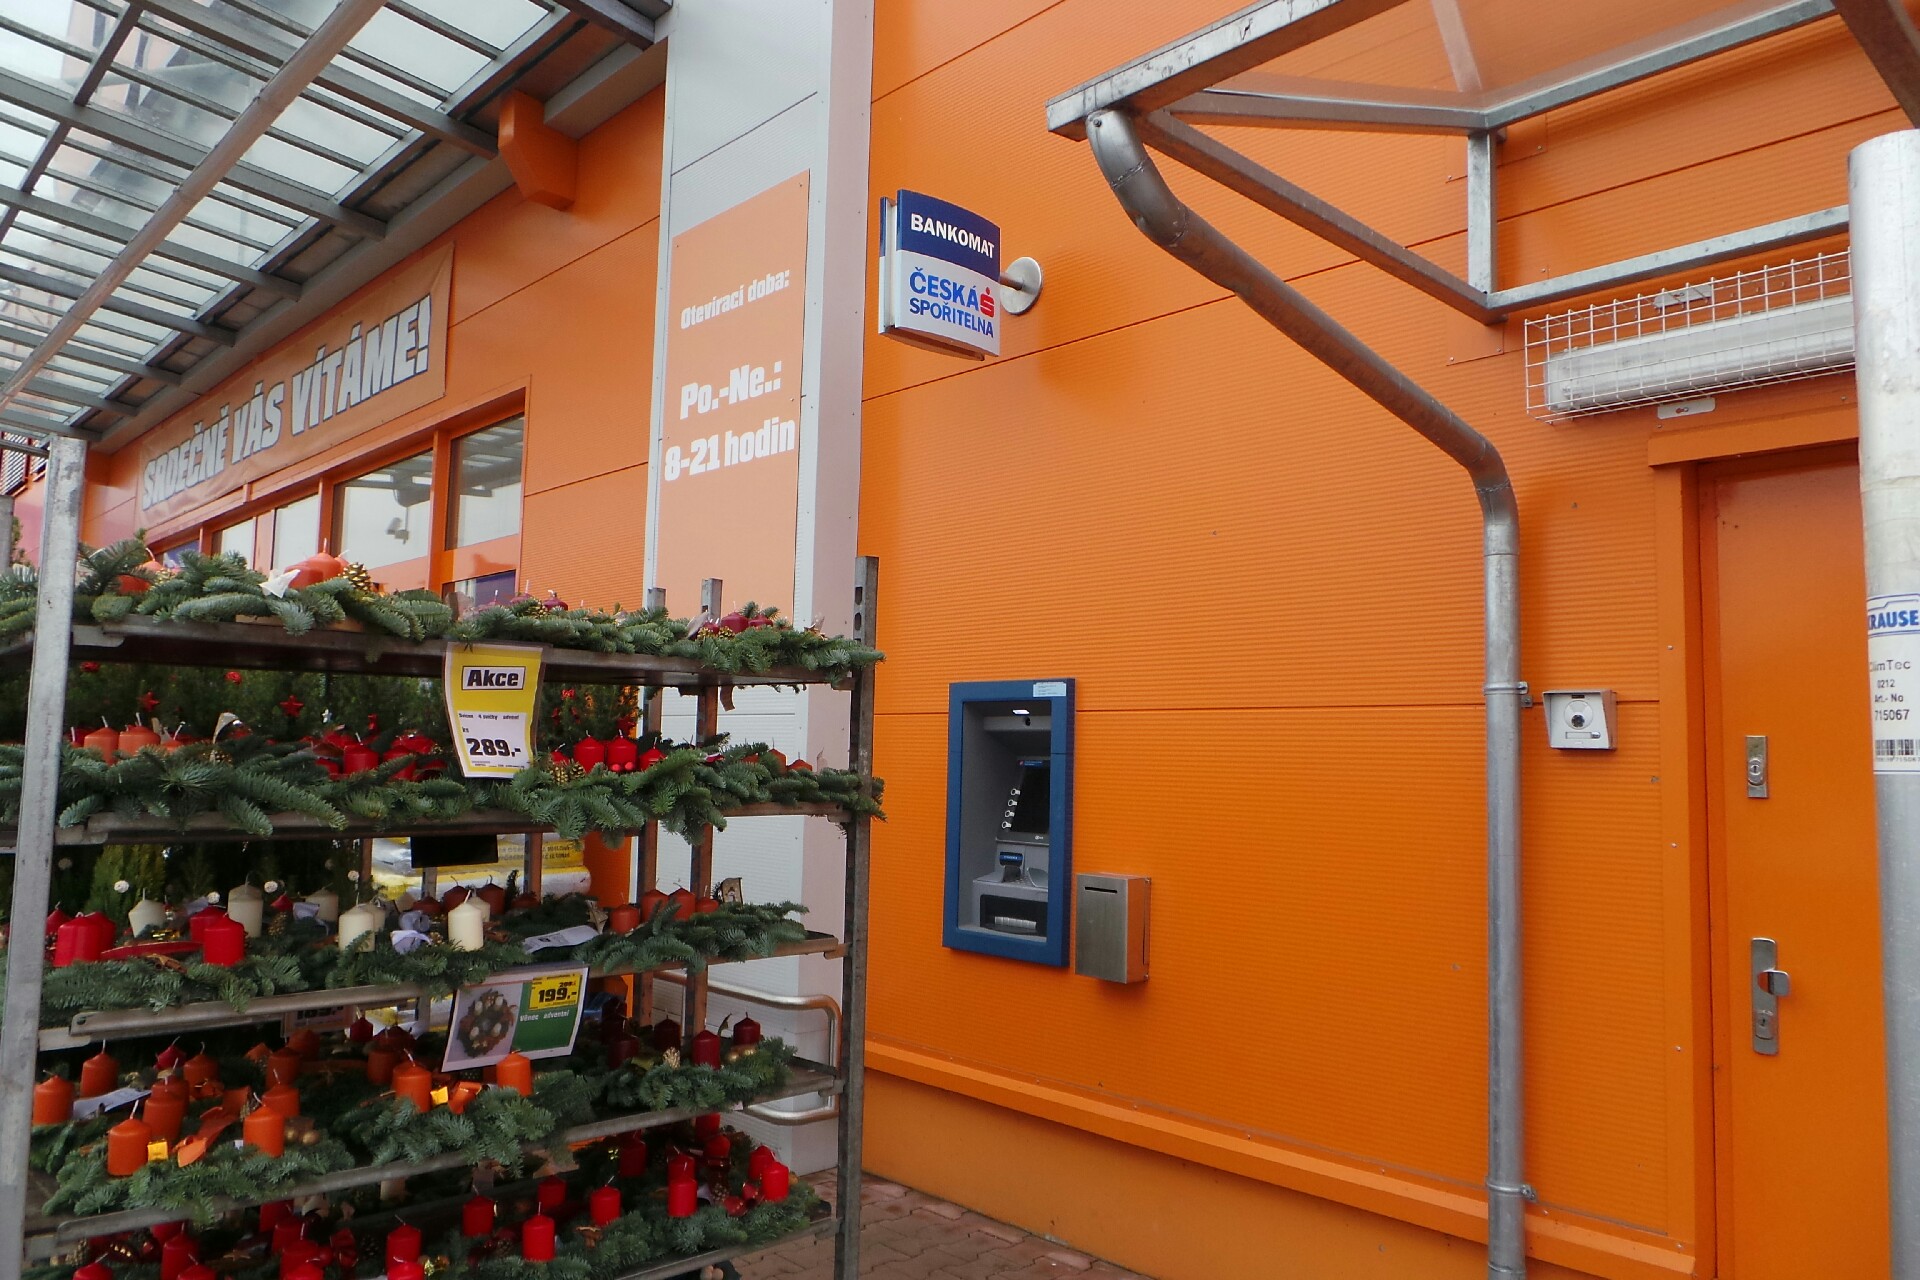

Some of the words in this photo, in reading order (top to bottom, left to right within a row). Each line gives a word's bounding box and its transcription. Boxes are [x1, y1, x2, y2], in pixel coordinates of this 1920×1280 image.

[910, 213, 995, 259] BANKOMAT
[681, 284, 744, 330] Otevírací
[747, 269, 790, 303] doba:
[909, 267, 979, 312] ČESKÁ
[909, 297, 994, 338] SPOŘITELNA
[142, 402, 230, 512] SRDEČNĚ
[231, 380, 285, 465] VÁS
[291, 293, 432, 437] VÍTÁME!
[680, 360, 782, 420] Po.-Ne.:
[664, 434, 720, 482] 8-21
[724, 416, 796, 467] hodin
[1868, 609, 1920, 631] RAUSE
[467, 669, 519, 687] Akce
[1874, 709, 1910, 721] 715067
